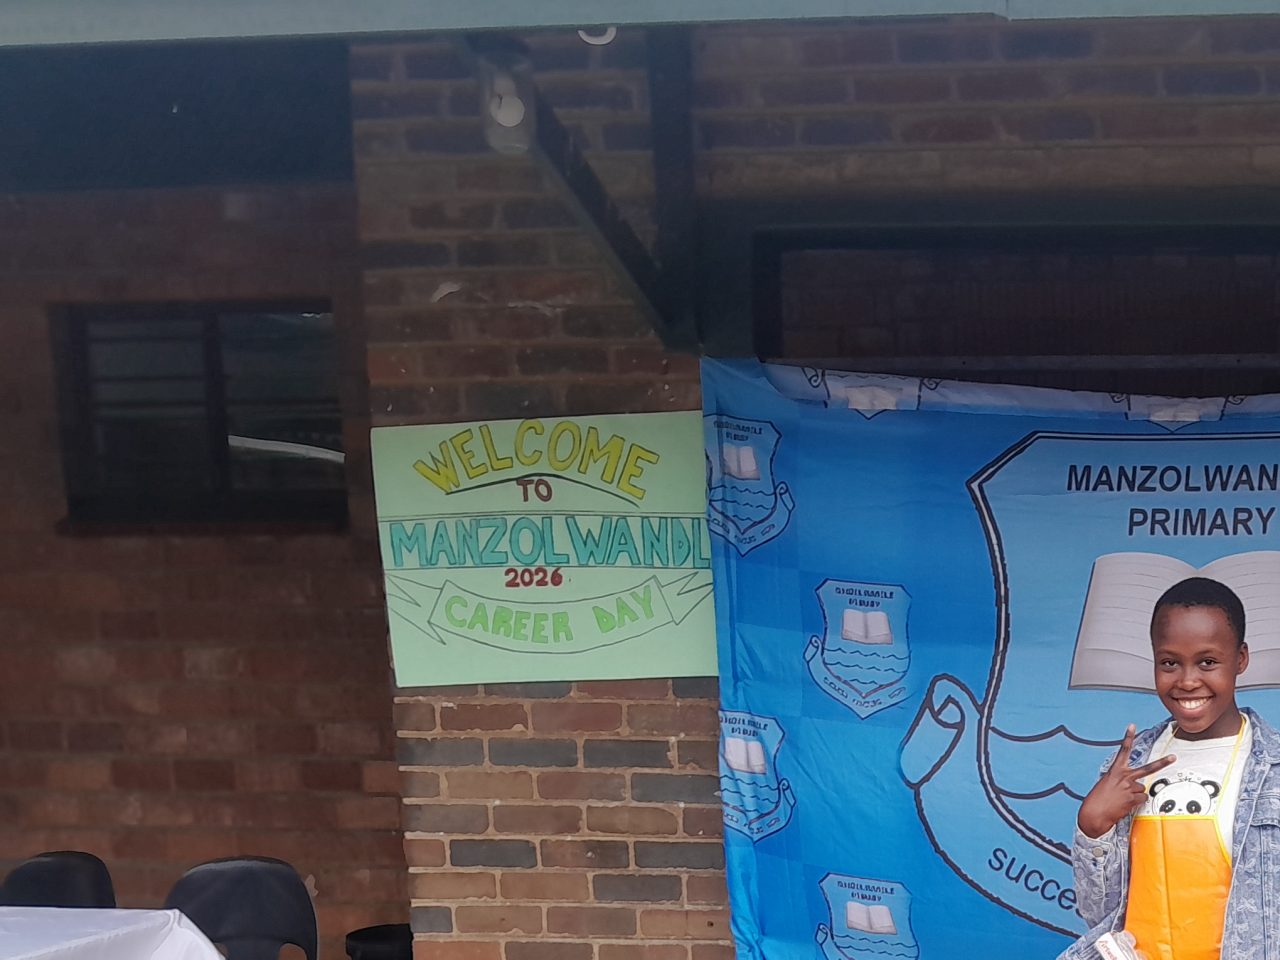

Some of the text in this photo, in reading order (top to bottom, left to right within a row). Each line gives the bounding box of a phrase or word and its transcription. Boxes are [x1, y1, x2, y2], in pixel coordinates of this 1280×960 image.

[414, 419, 659, 499] WELCOME
[516, 478, 553, 502] TO
[1128, 507, 1276, 536] PRIMARY
[504, 567, 564, 588] 2026
[446, 586, 654, 643] CAREER DAY
